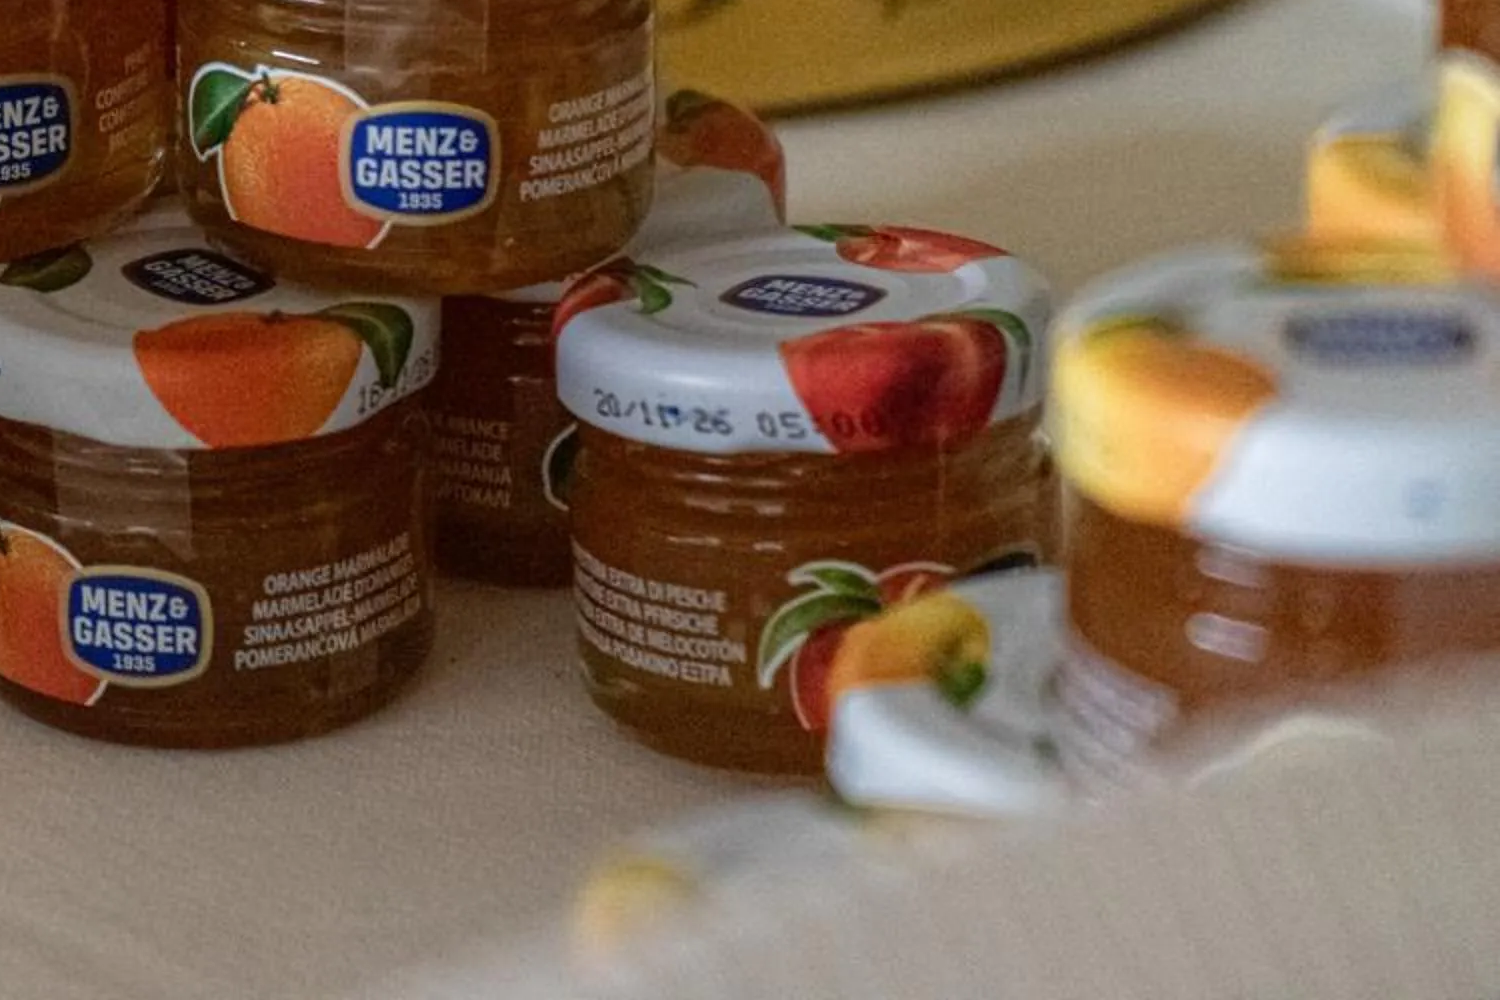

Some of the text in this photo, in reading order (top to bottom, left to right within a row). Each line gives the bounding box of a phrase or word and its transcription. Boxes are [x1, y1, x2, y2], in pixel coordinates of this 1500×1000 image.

[366, 125, 479, 156] MENZ&
[356, 158, 486, 190] GASSER
[398, 192, 443, 209] 1935
[263, 564, 332, 597] ORANGE
[81, 585, 188, 621] MENZ&
[252, 582, 353, 622] MARMELADE
[74, 615, 197, 655] GASSER
[112, 652, 157, 672] 1935
